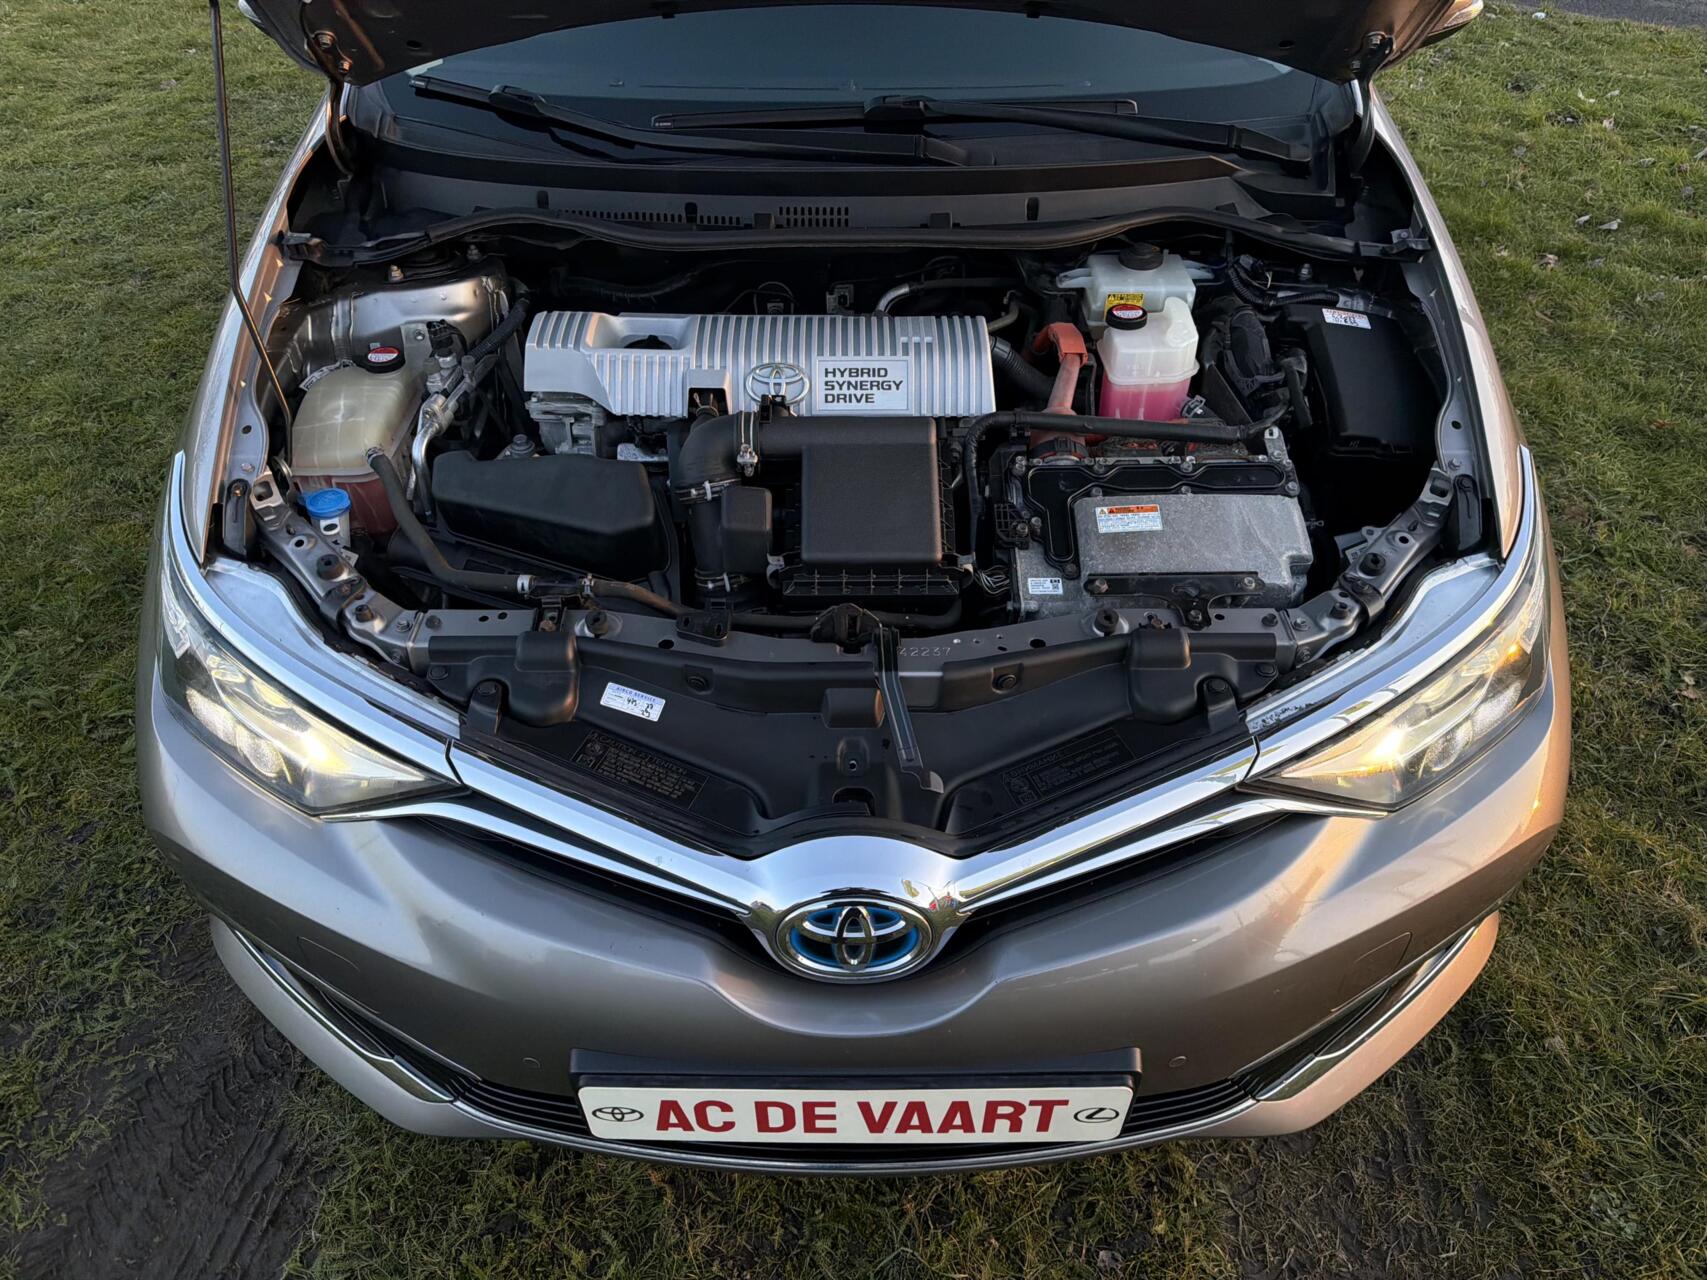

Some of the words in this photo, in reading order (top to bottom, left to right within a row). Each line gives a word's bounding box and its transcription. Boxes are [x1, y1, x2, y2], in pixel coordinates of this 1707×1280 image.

[824, 367, 889, 378] HYBRID
[824, 380, 903, 391] SYNERGY
[824, 393, 875, 404] DRIVE
[655, 1099, 736, 1132] AC
[754, 1100, 838, 1134] DE
[857, 1099, 1070, 1134] VAART
